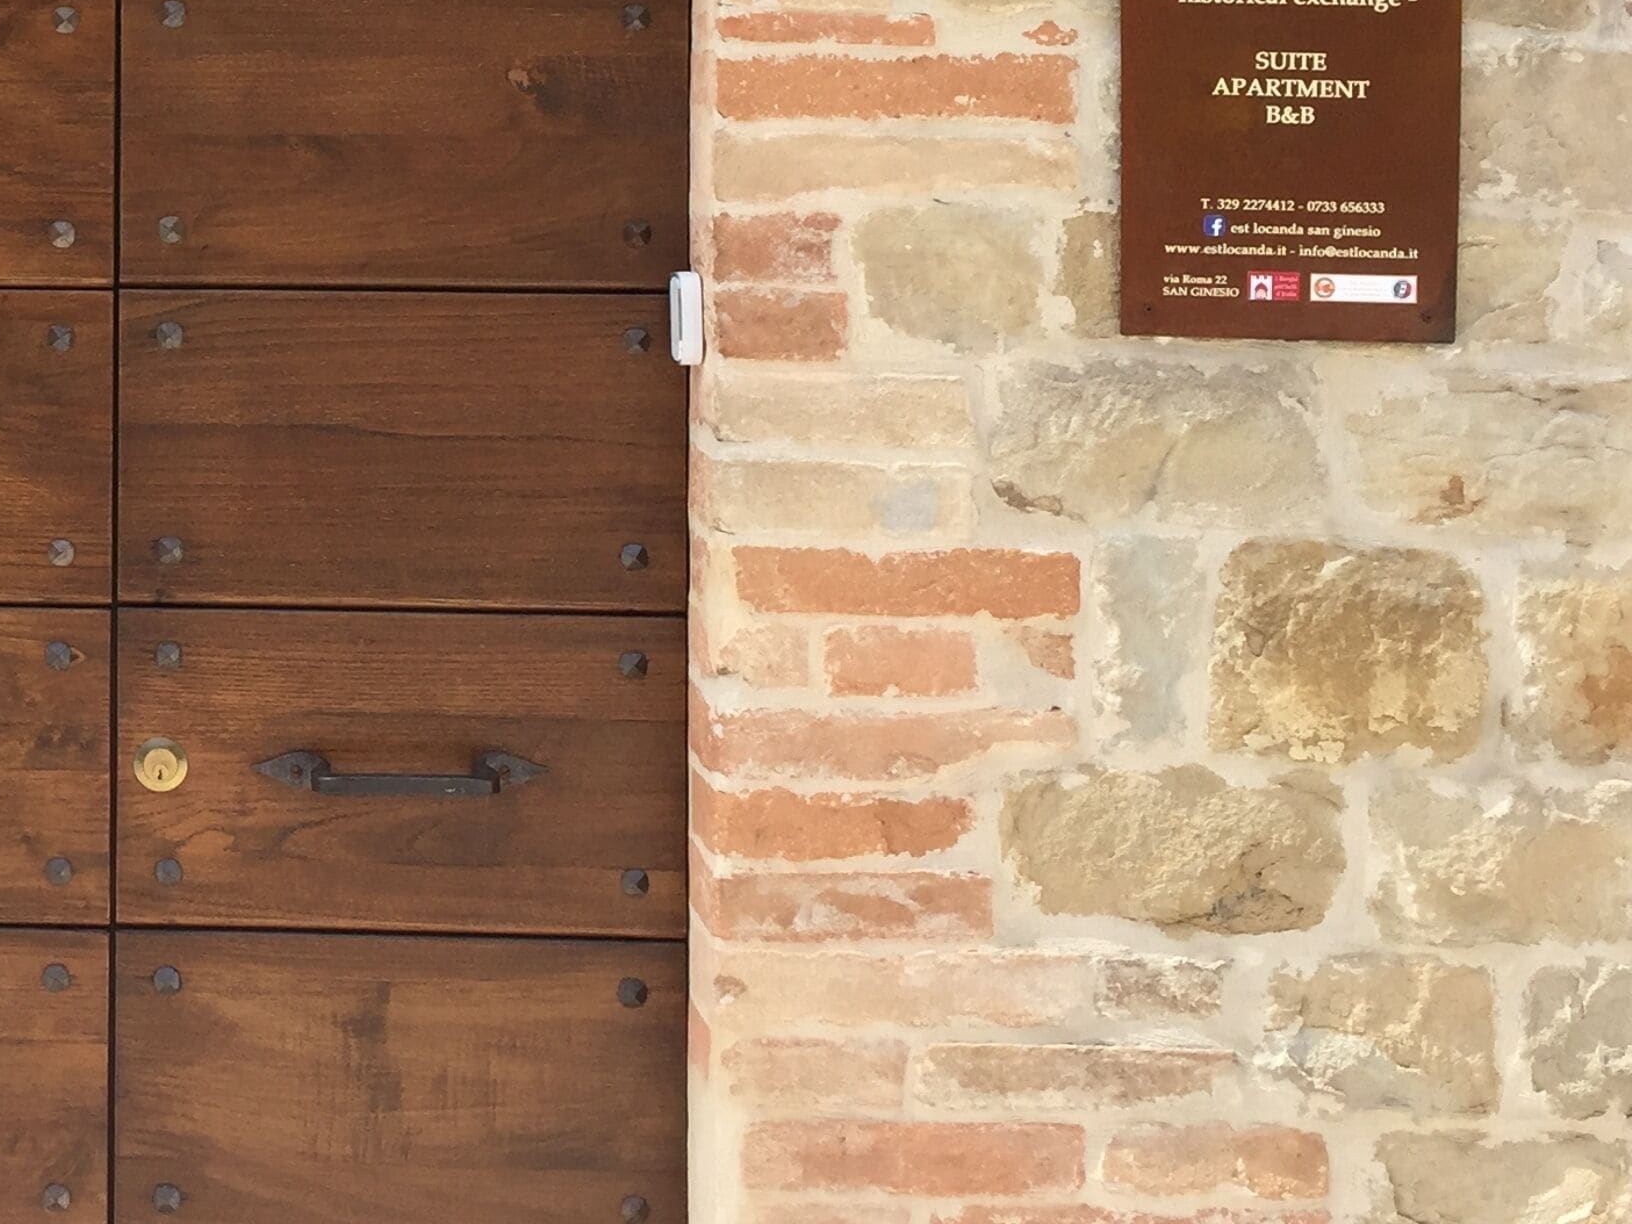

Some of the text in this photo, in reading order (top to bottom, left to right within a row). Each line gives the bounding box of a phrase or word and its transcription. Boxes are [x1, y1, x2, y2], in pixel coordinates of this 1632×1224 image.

[1255, 51, 1327, 71] SUITE
[1212, 77, 1370, 99] APARTMENT
[1265, 105, 1316, 124] B&B
[1200, 198, 1213, 210] T.
[1217, 198, 1239, 210] 329
[1242, 199, 1295, 211] 2274412
[1306, 200, 1337, 213] 0733
[1339, 202, 1385, 214] 656333
[1230, 224, 1250, 234] est
[1253, 223, 1304, 236] locanda
[1307, 227, 1330, 236] san
[1333, 225, 1381, 239] ginesio
[1164, 243, 1287, 256] www.estlocanda.it
[1299, 245, 1419, 259] info@estlocanda.it
[1163, 274, 1228, 285] via Roma 22
[1162, 287, 1240, 297] SAN GINESIO
